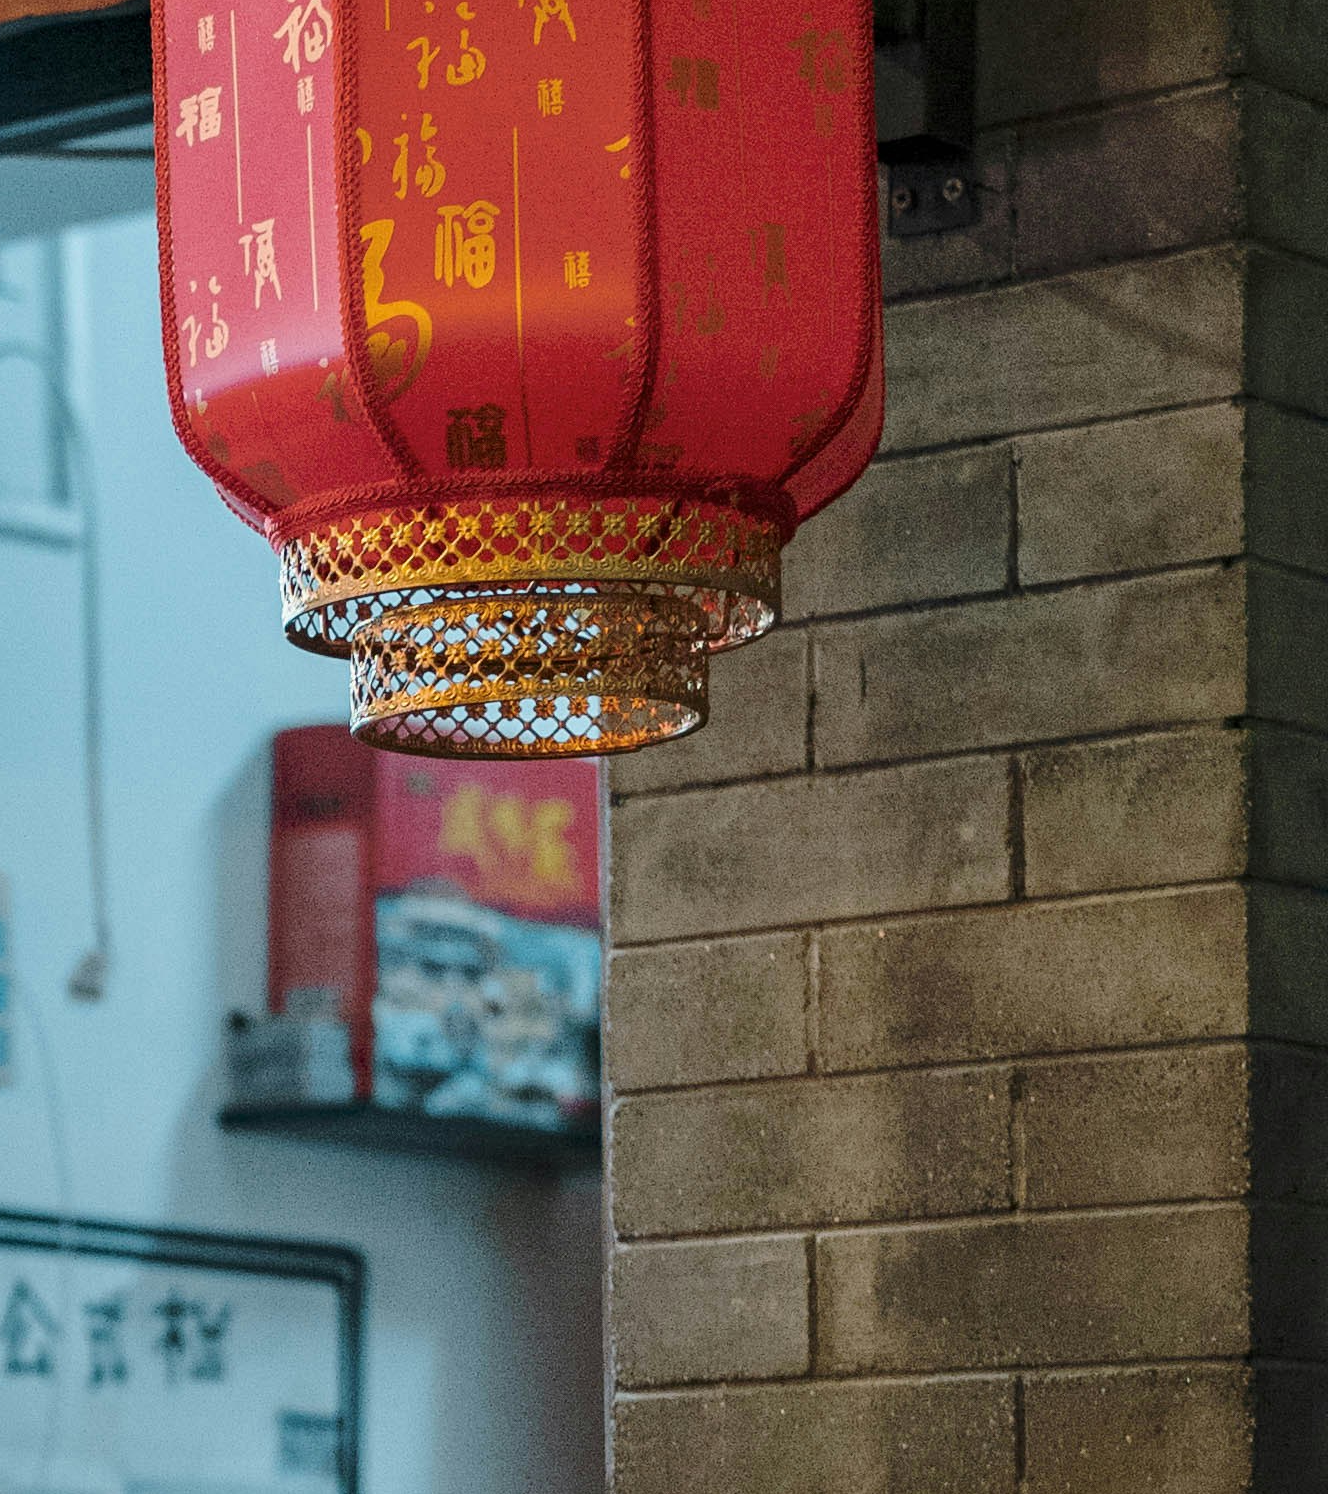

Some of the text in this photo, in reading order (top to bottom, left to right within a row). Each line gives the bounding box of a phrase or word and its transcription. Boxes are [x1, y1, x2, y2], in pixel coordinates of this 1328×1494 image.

[406, 0, 487, 91] 福
[175, 85, 222, 147] 福
[433, 199, 501, 290] 福
